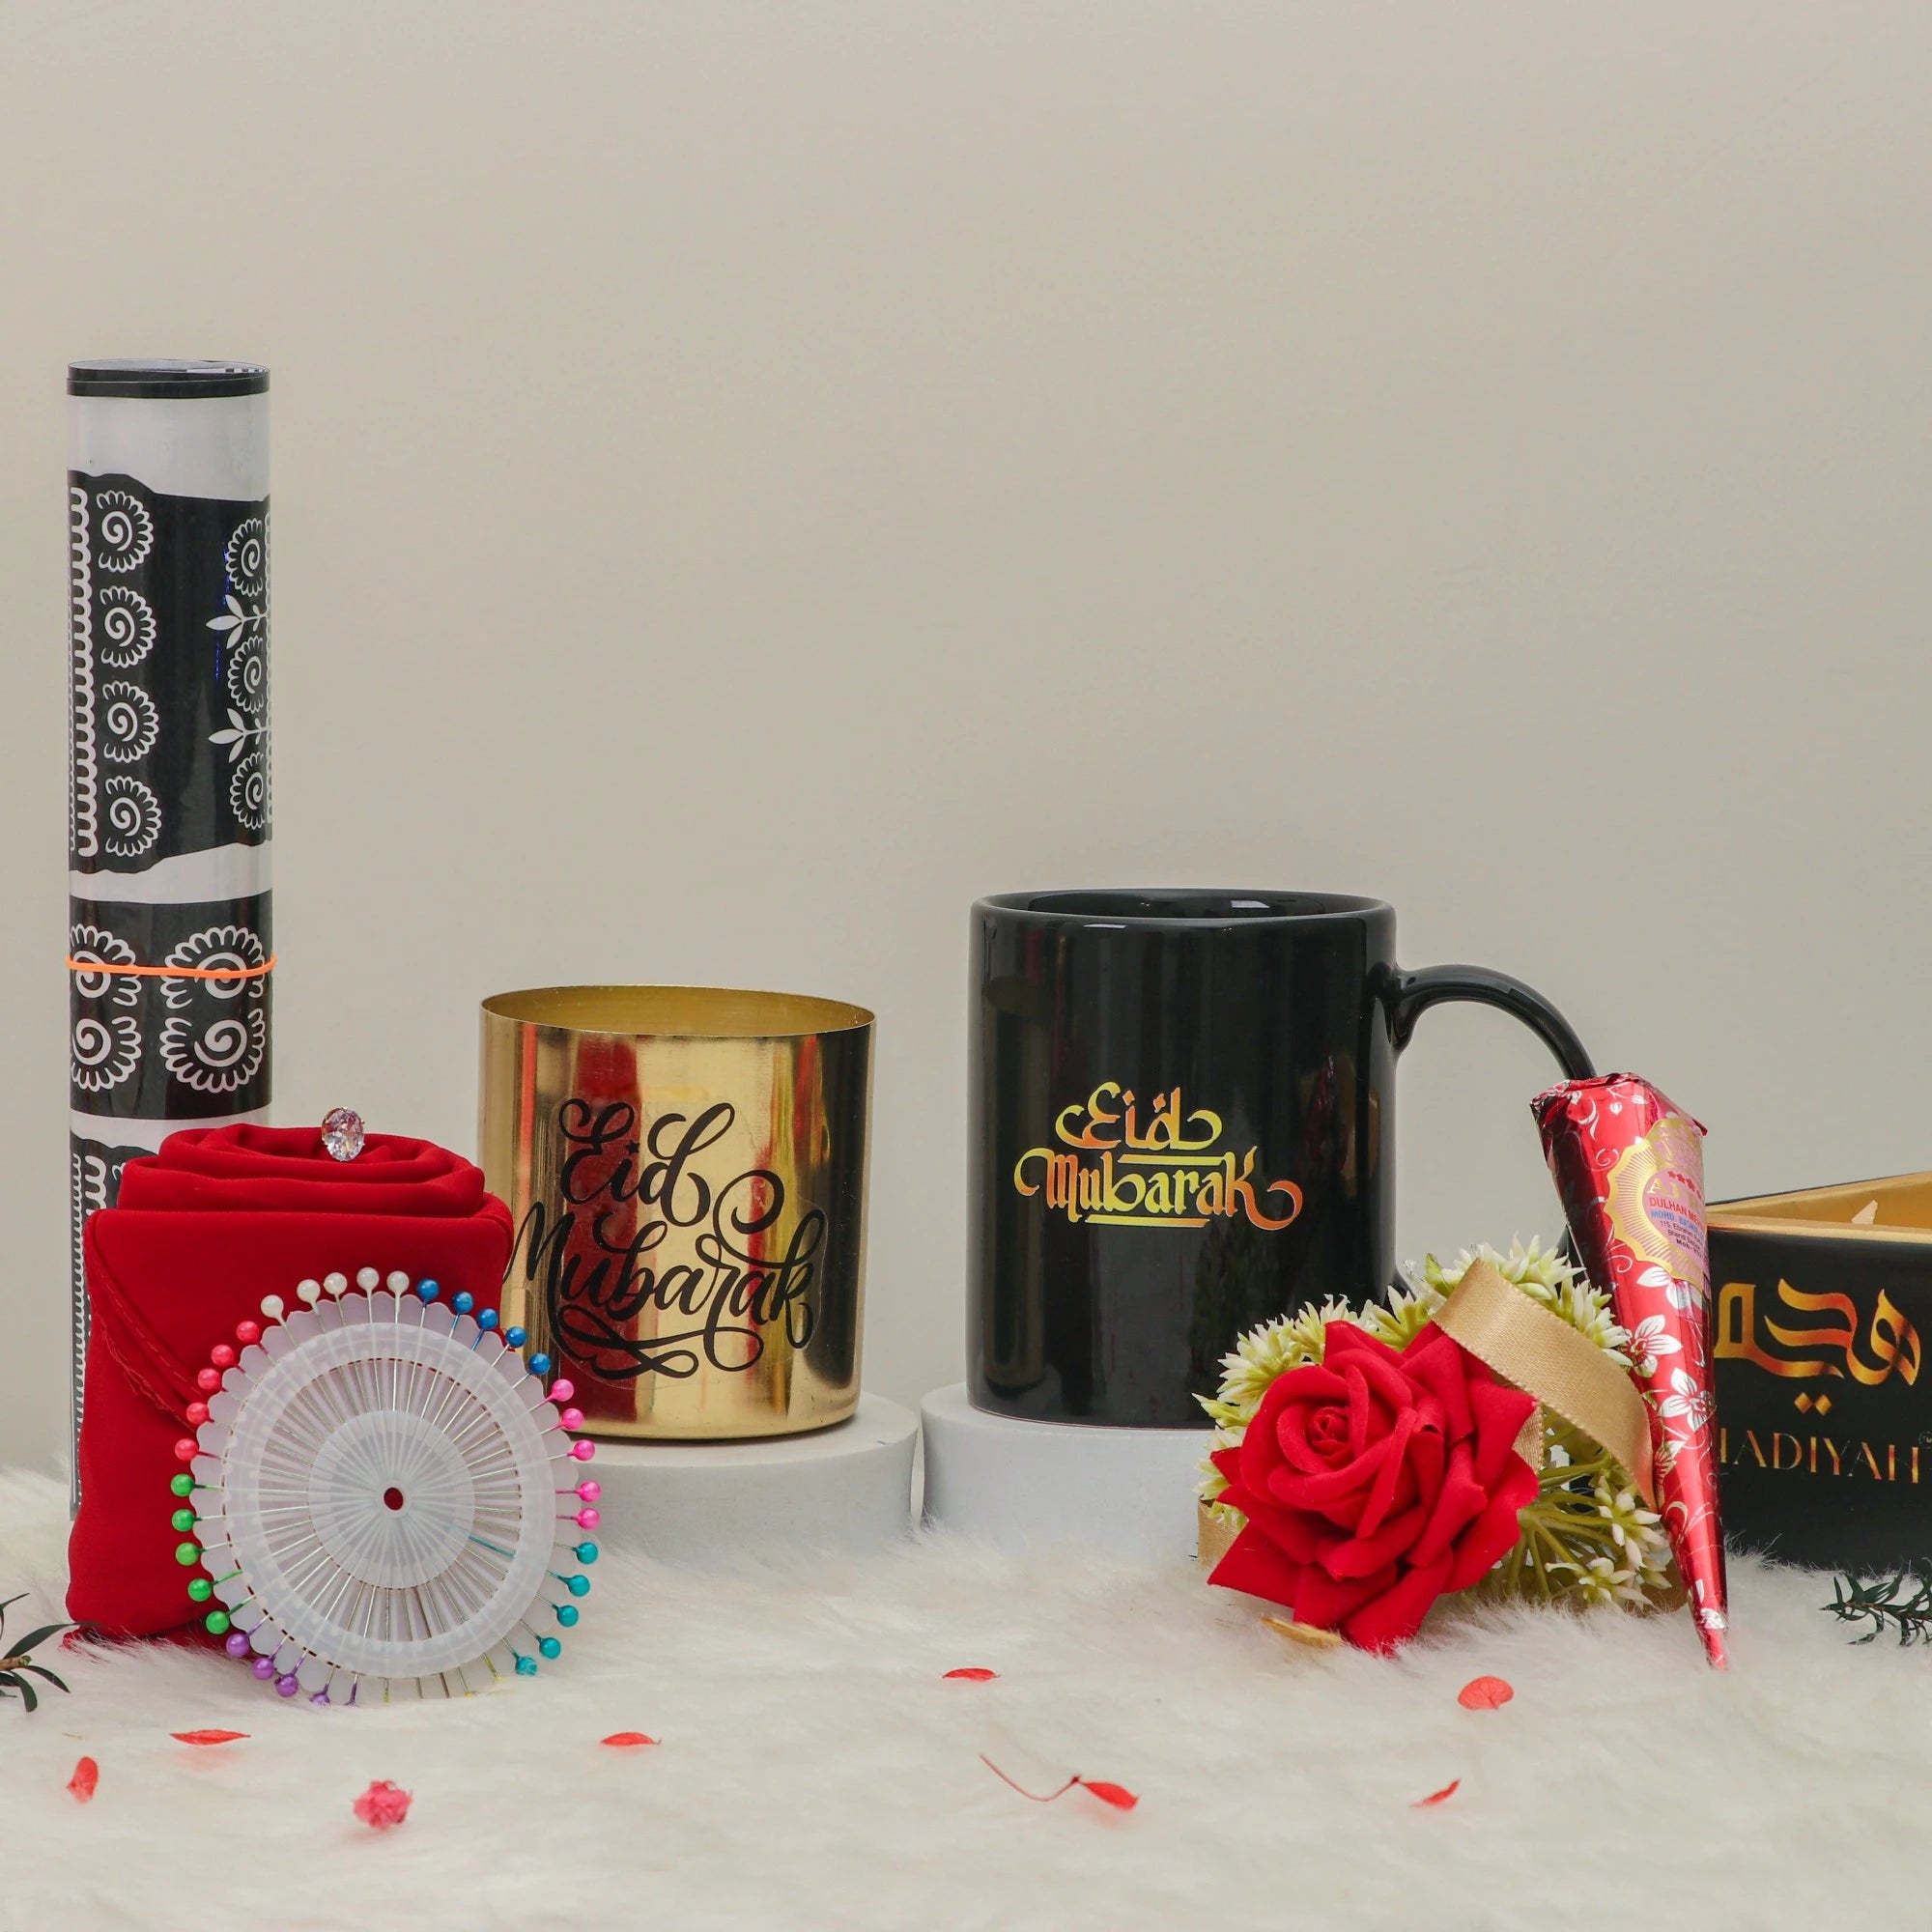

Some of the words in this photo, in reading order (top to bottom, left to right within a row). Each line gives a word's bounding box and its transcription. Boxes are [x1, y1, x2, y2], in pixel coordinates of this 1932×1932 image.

[1055, 1081, 1223, 1151] Eid
[559, 1098, 735, 1227] Eid
[1014, 1146, 1303, 1232] Mubarak
[1649, 1197, 1688, 1216] DULHAN
[502, 1170, 827, 1379] Mubarak
